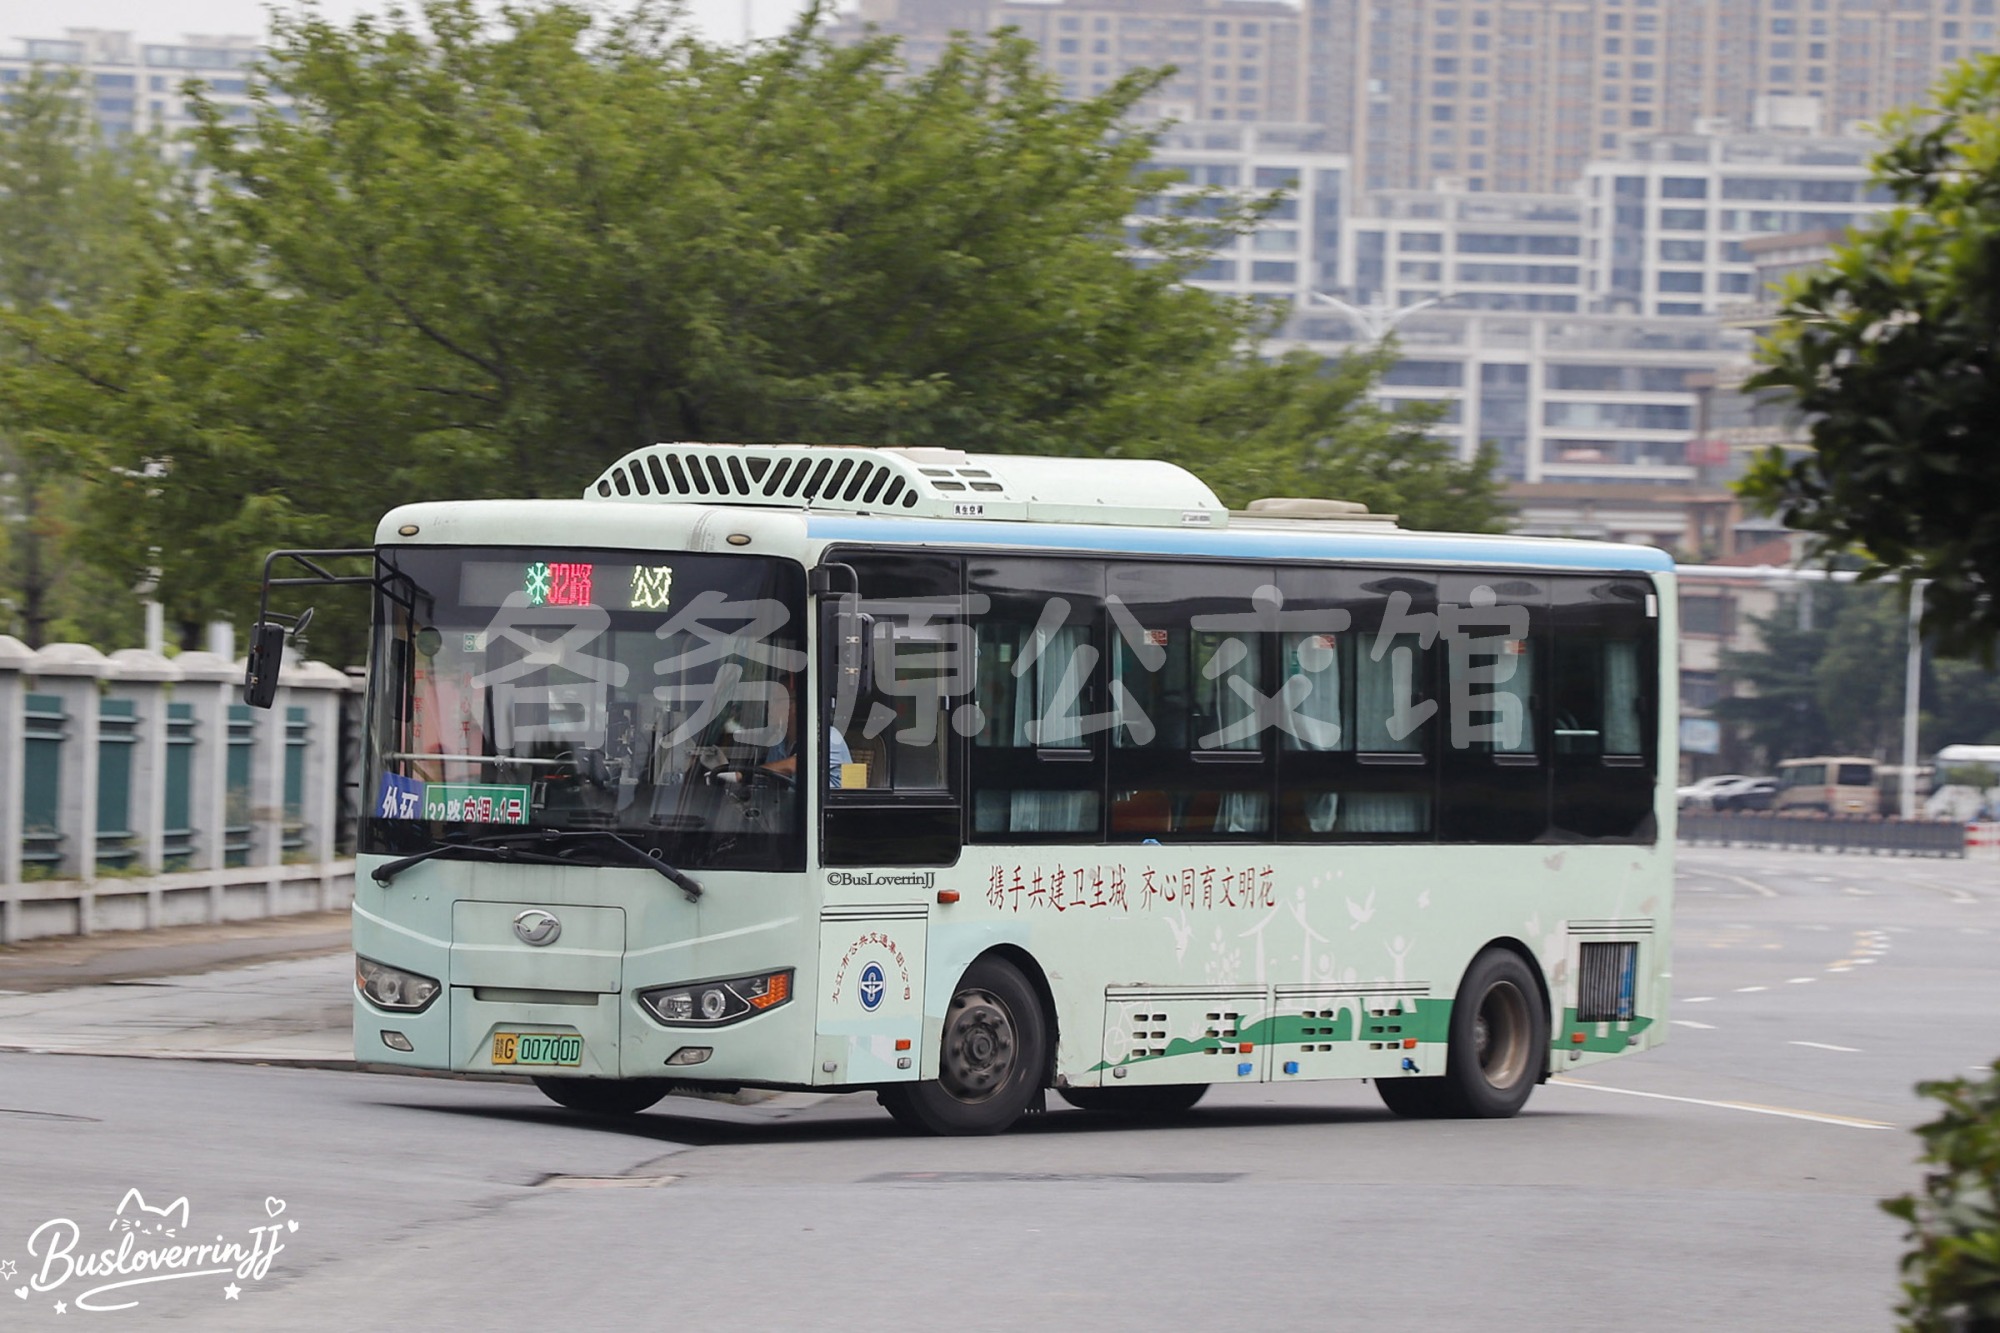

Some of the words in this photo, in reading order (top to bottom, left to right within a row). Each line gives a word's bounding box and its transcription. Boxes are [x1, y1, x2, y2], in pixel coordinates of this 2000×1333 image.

[548, 563, 592, 606] 32路
[630, 565, 673, 608] 公交
[986, 863, 1129, 913] 携手共建卫生城
[1140, 864, 1276, 912] 齐心同育文明花
